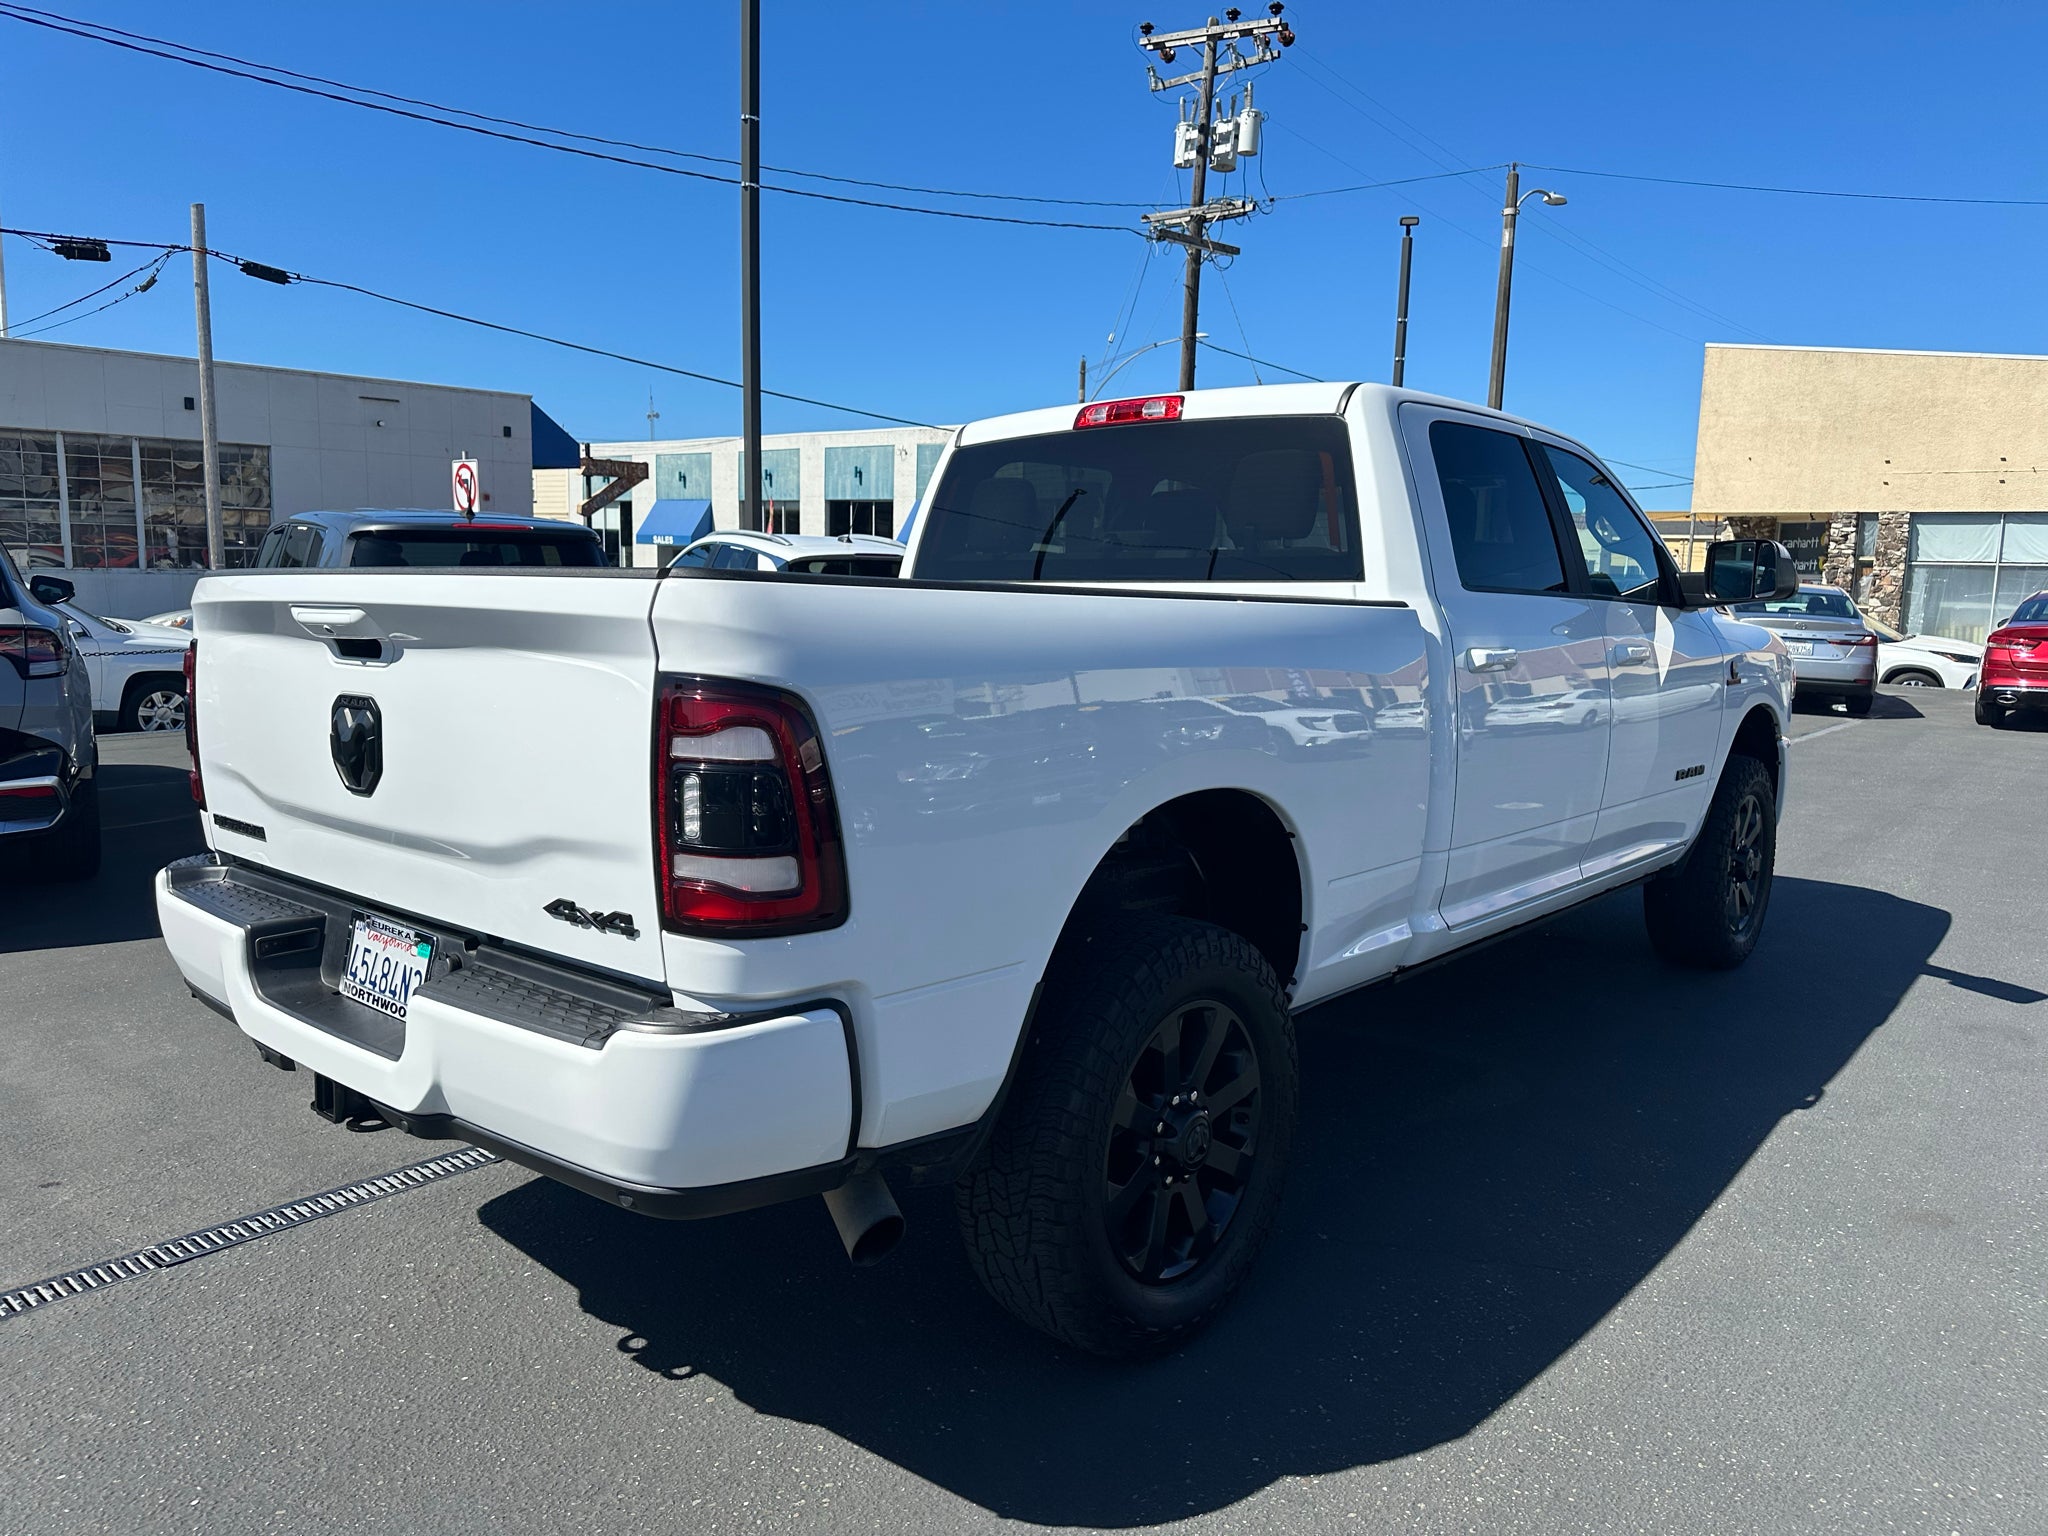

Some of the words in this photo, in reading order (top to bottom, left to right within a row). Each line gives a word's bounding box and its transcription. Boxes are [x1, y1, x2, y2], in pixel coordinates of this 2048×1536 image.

[653, 535, 674, 544] SALES
[1782, 536, 1819, 548] carhartt
[1793, 559, 1817, 571] hartt
[341, 697, 368, 707] RAM
[1675, 764, 1705, 781] RAM
[372, 920, 412, 940] EUREKA
[344, 981, 407, 1018] NORTHWOO
